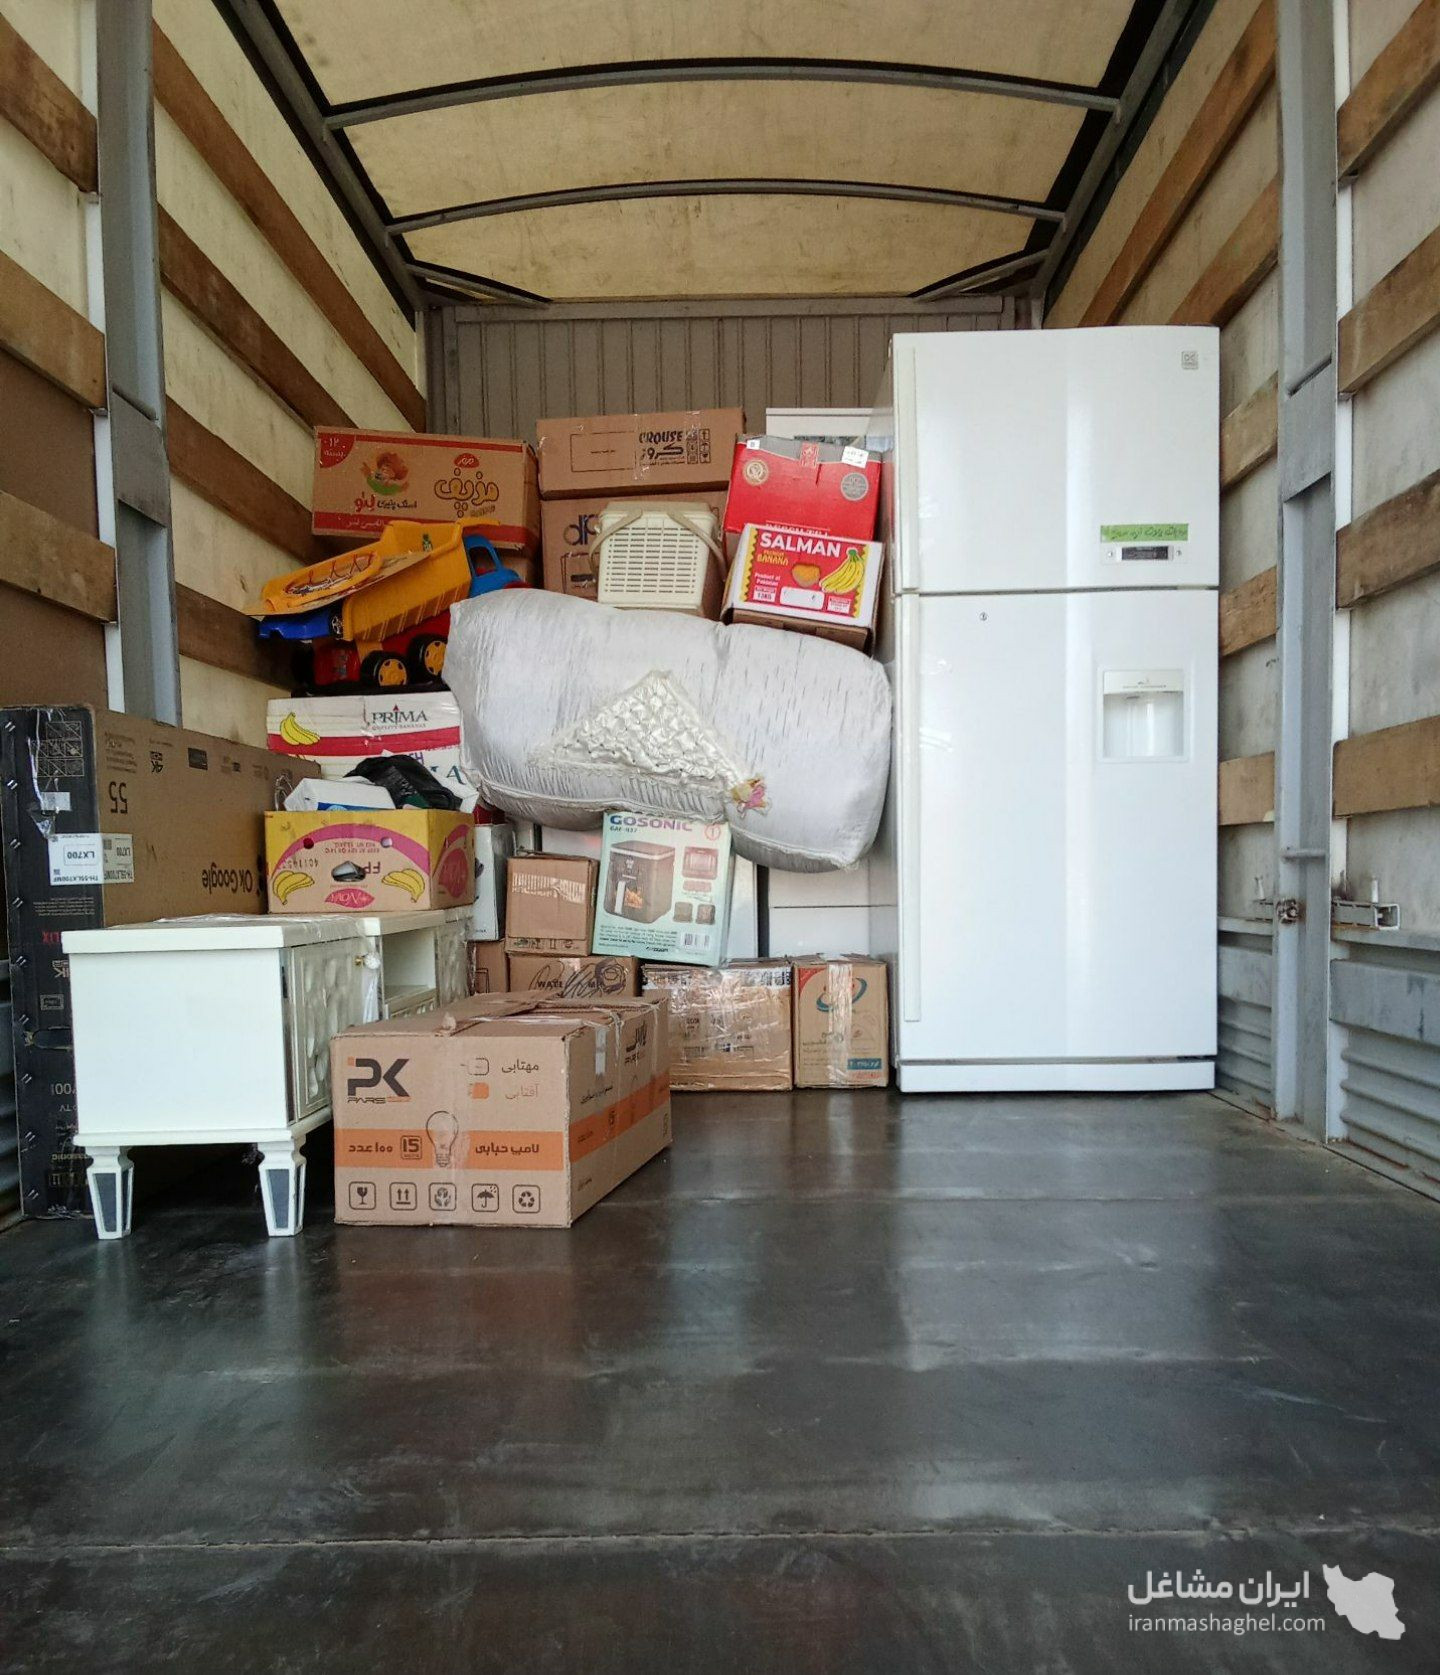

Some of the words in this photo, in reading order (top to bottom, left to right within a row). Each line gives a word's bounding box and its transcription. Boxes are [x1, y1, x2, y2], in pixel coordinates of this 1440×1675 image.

[639, 430, 683, 444] CROUSE
[759, 532, 841, 558] SALMAN
[371, 704, 428, 724] PRIMA
[108, 781, 129, 814] 55
[609, 814, 693, 832] GOSONIC
[67, 850, 95, 859] LX700
[201, 861, 238, 895] Google
[501, 1058, 539, 1074] مهتابی
[347, 1056, 410, 1097] PK
[505, 1082, 540, 1100] آفتابی
[347, 1096, 386, 1104] PARS
[348, 1144, 373, 1152] عدد
[402, 1138, 420, 1153] 15
[475, 1141, 508, 1156] حبابی
[510, 1143, 540, 1155] لامپ
